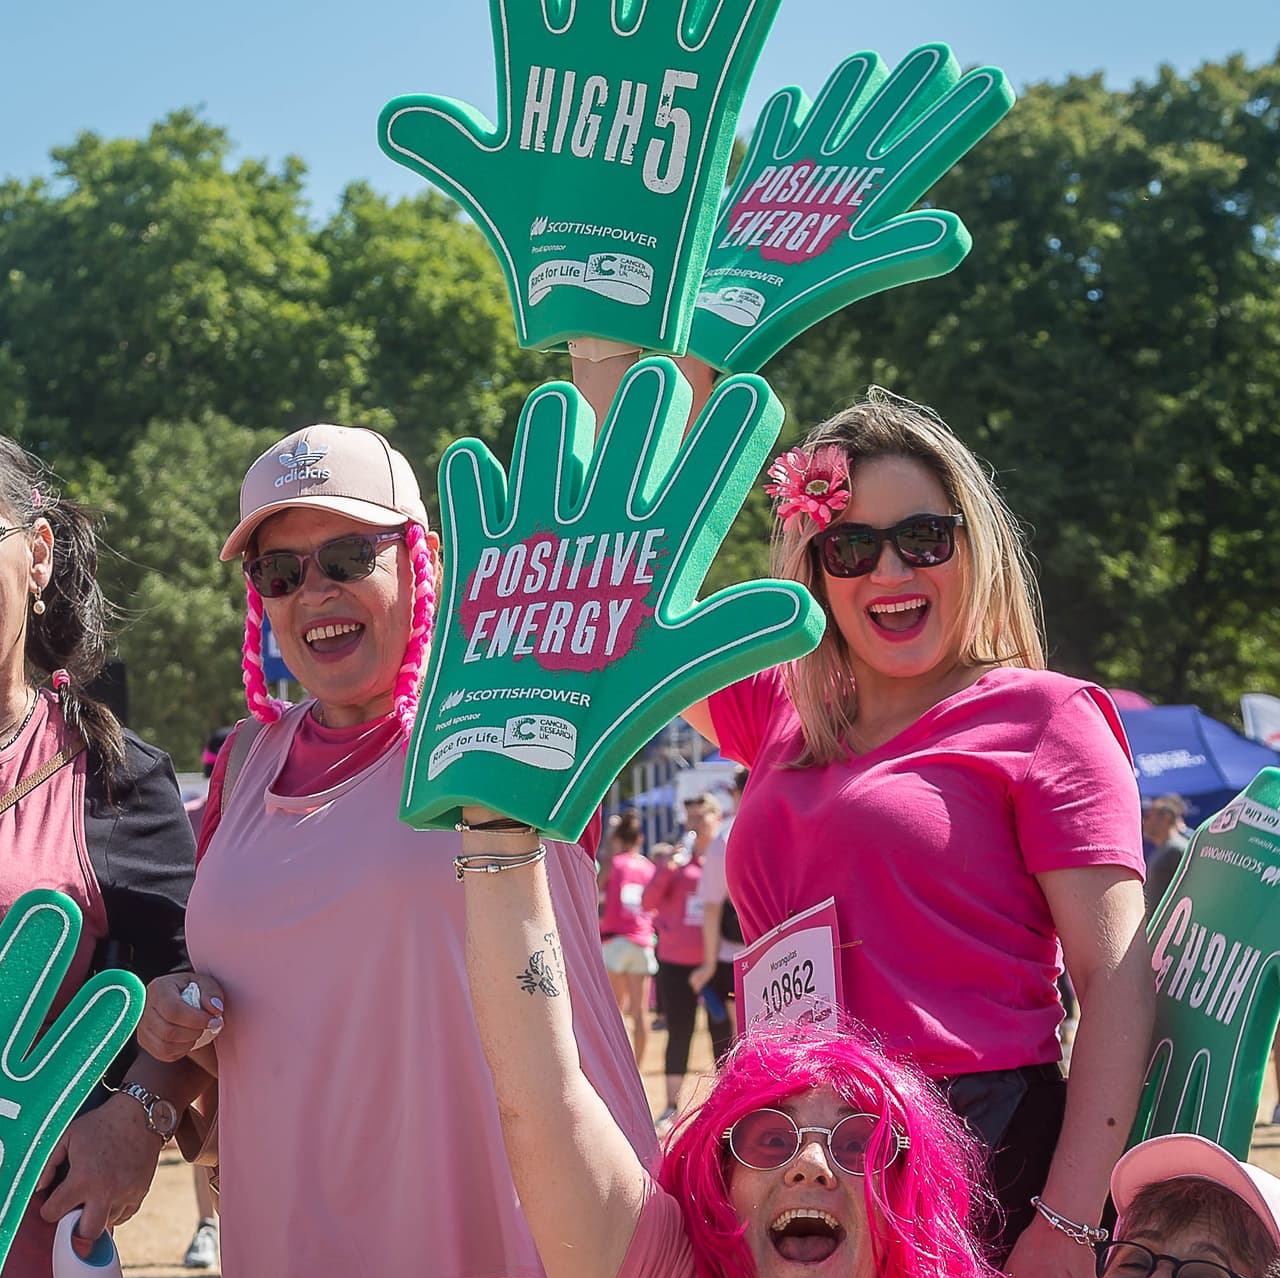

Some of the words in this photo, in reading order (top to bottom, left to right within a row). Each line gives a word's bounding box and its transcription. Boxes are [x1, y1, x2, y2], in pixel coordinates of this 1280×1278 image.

[520, 65, 648, 165] HIGH
[641, 70, 699, 195] 5
[750, 165, 887, 208] POSITIVE
[546, 221, 658, 248] SCOTTISHPOWER
[718, 209, 844, 257] ENERGY
[545, 267, 559, 278] for
[560, 266, 581, 279] Life
[274, 468, 331, 488] adidas
[468, 527, 665, 601] POSITIVE
[463, 598, 632, 664] ENERGY
[464, 688, 591, 707] SCOTTISHPOWER
[539, 733, 550, 741] UK
[540, 719, 569, 730] CANCER
[540, 726, 574, 741] RESEARCH
[432, 741, 454, 765] Race
[455, 735, 473, 747] for
[475, 733, 499, 744] Life
[1264, 815, 1280, 826] for
[1152, 896, 1192, 994] 5
[770, 949, 798, 972] Moranguitas
[1167, 920, 1261, 1026] HIGH
[762, 959, 816, 1021] 10862
